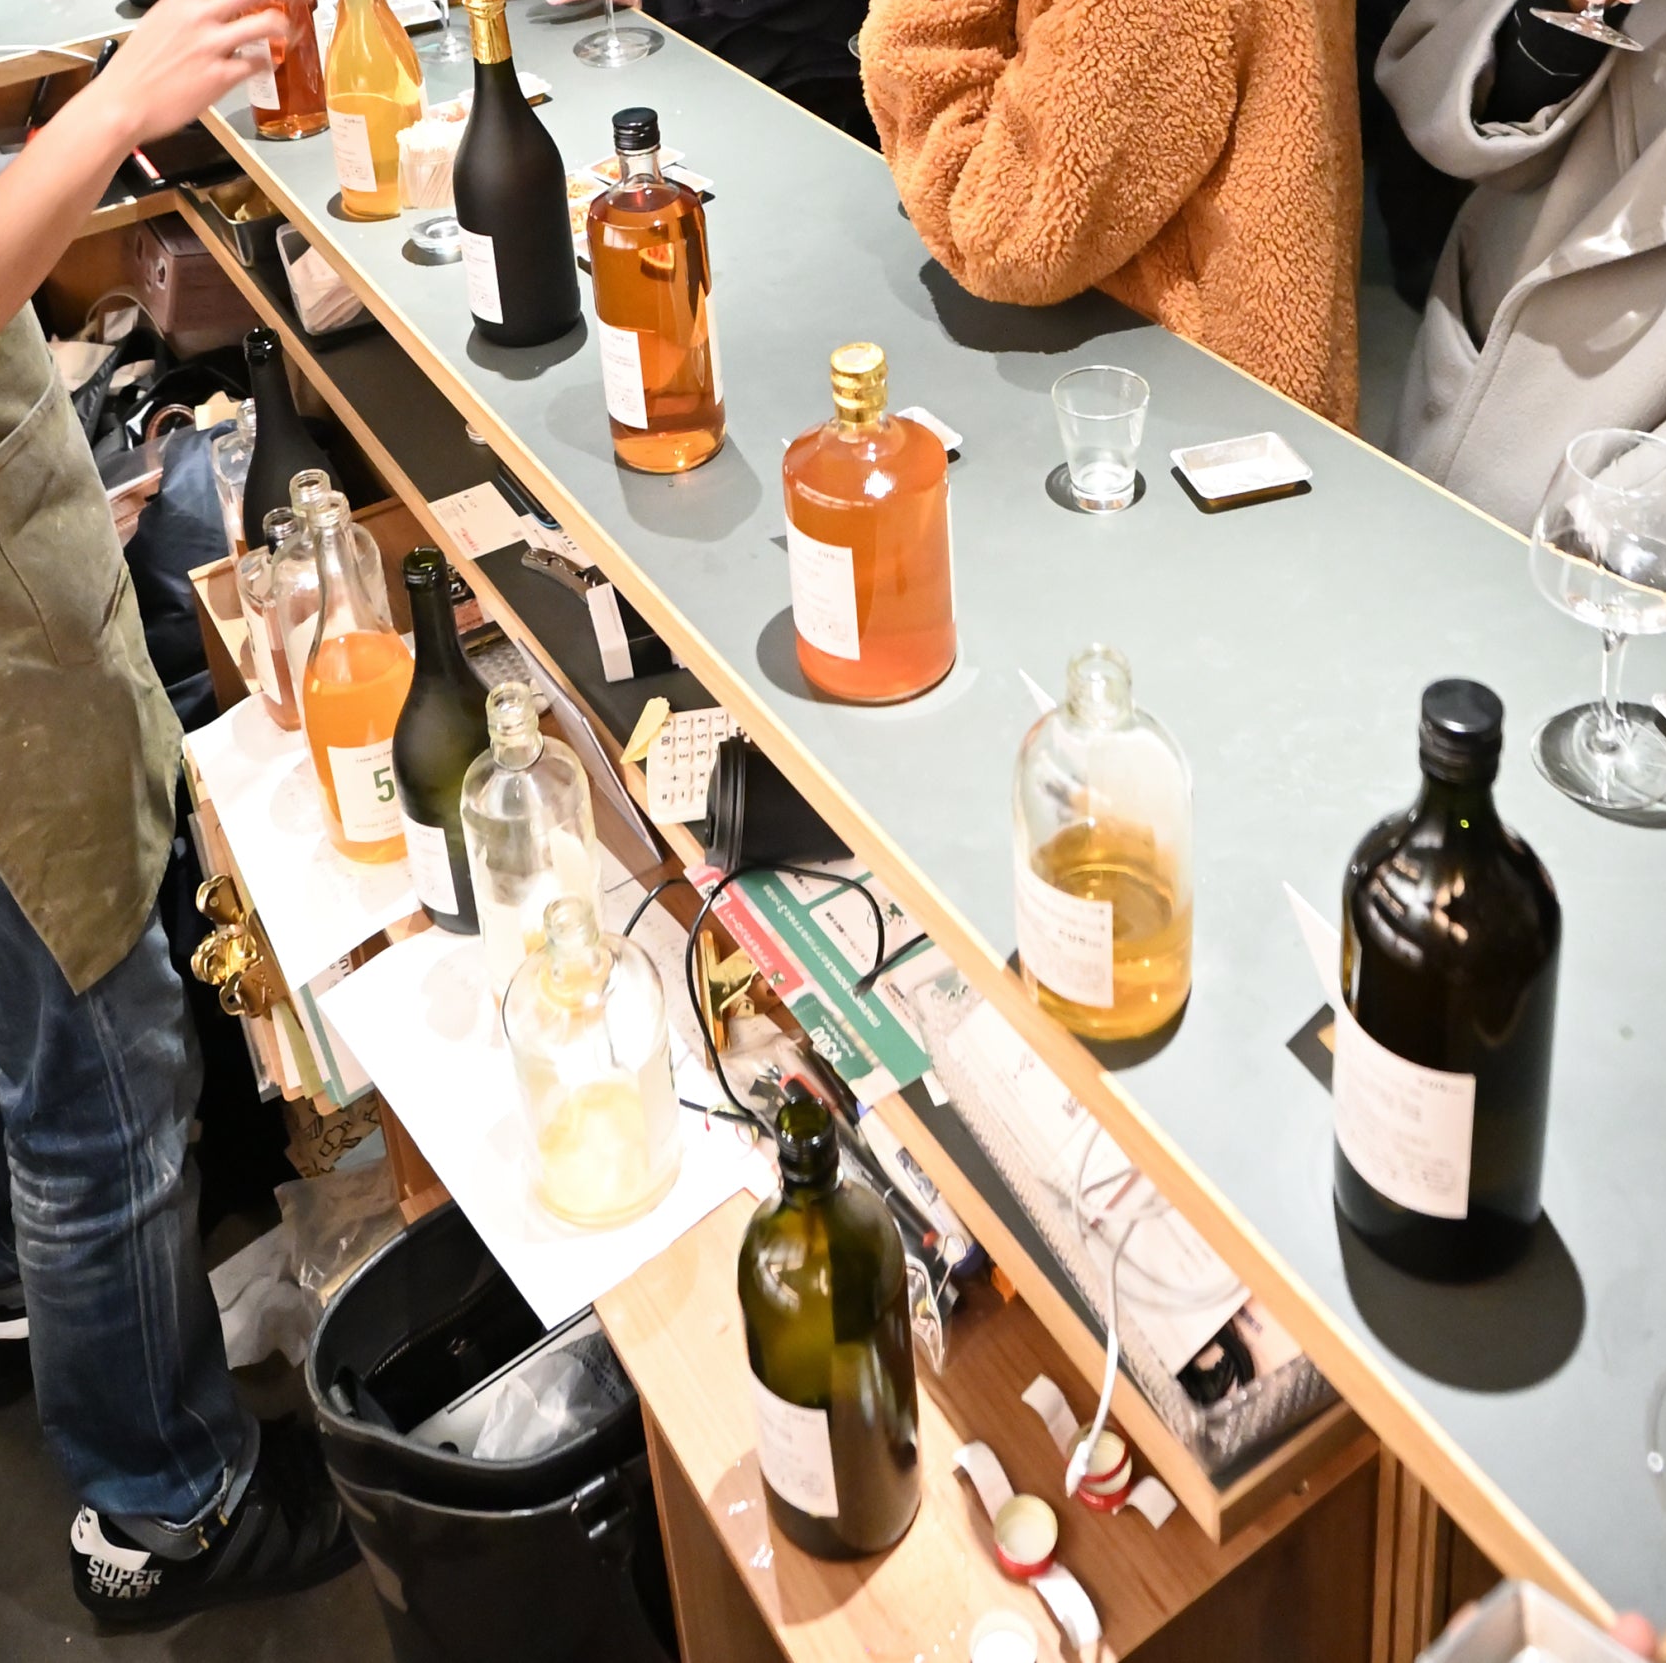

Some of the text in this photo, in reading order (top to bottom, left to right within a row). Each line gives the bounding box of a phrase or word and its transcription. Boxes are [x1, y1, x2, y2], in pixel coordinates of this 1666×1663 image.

[373, 766, 395, 802] 5
[87, 1555, 162, 1586] SUPER
[90, 1579, 152, 1600] STAR
